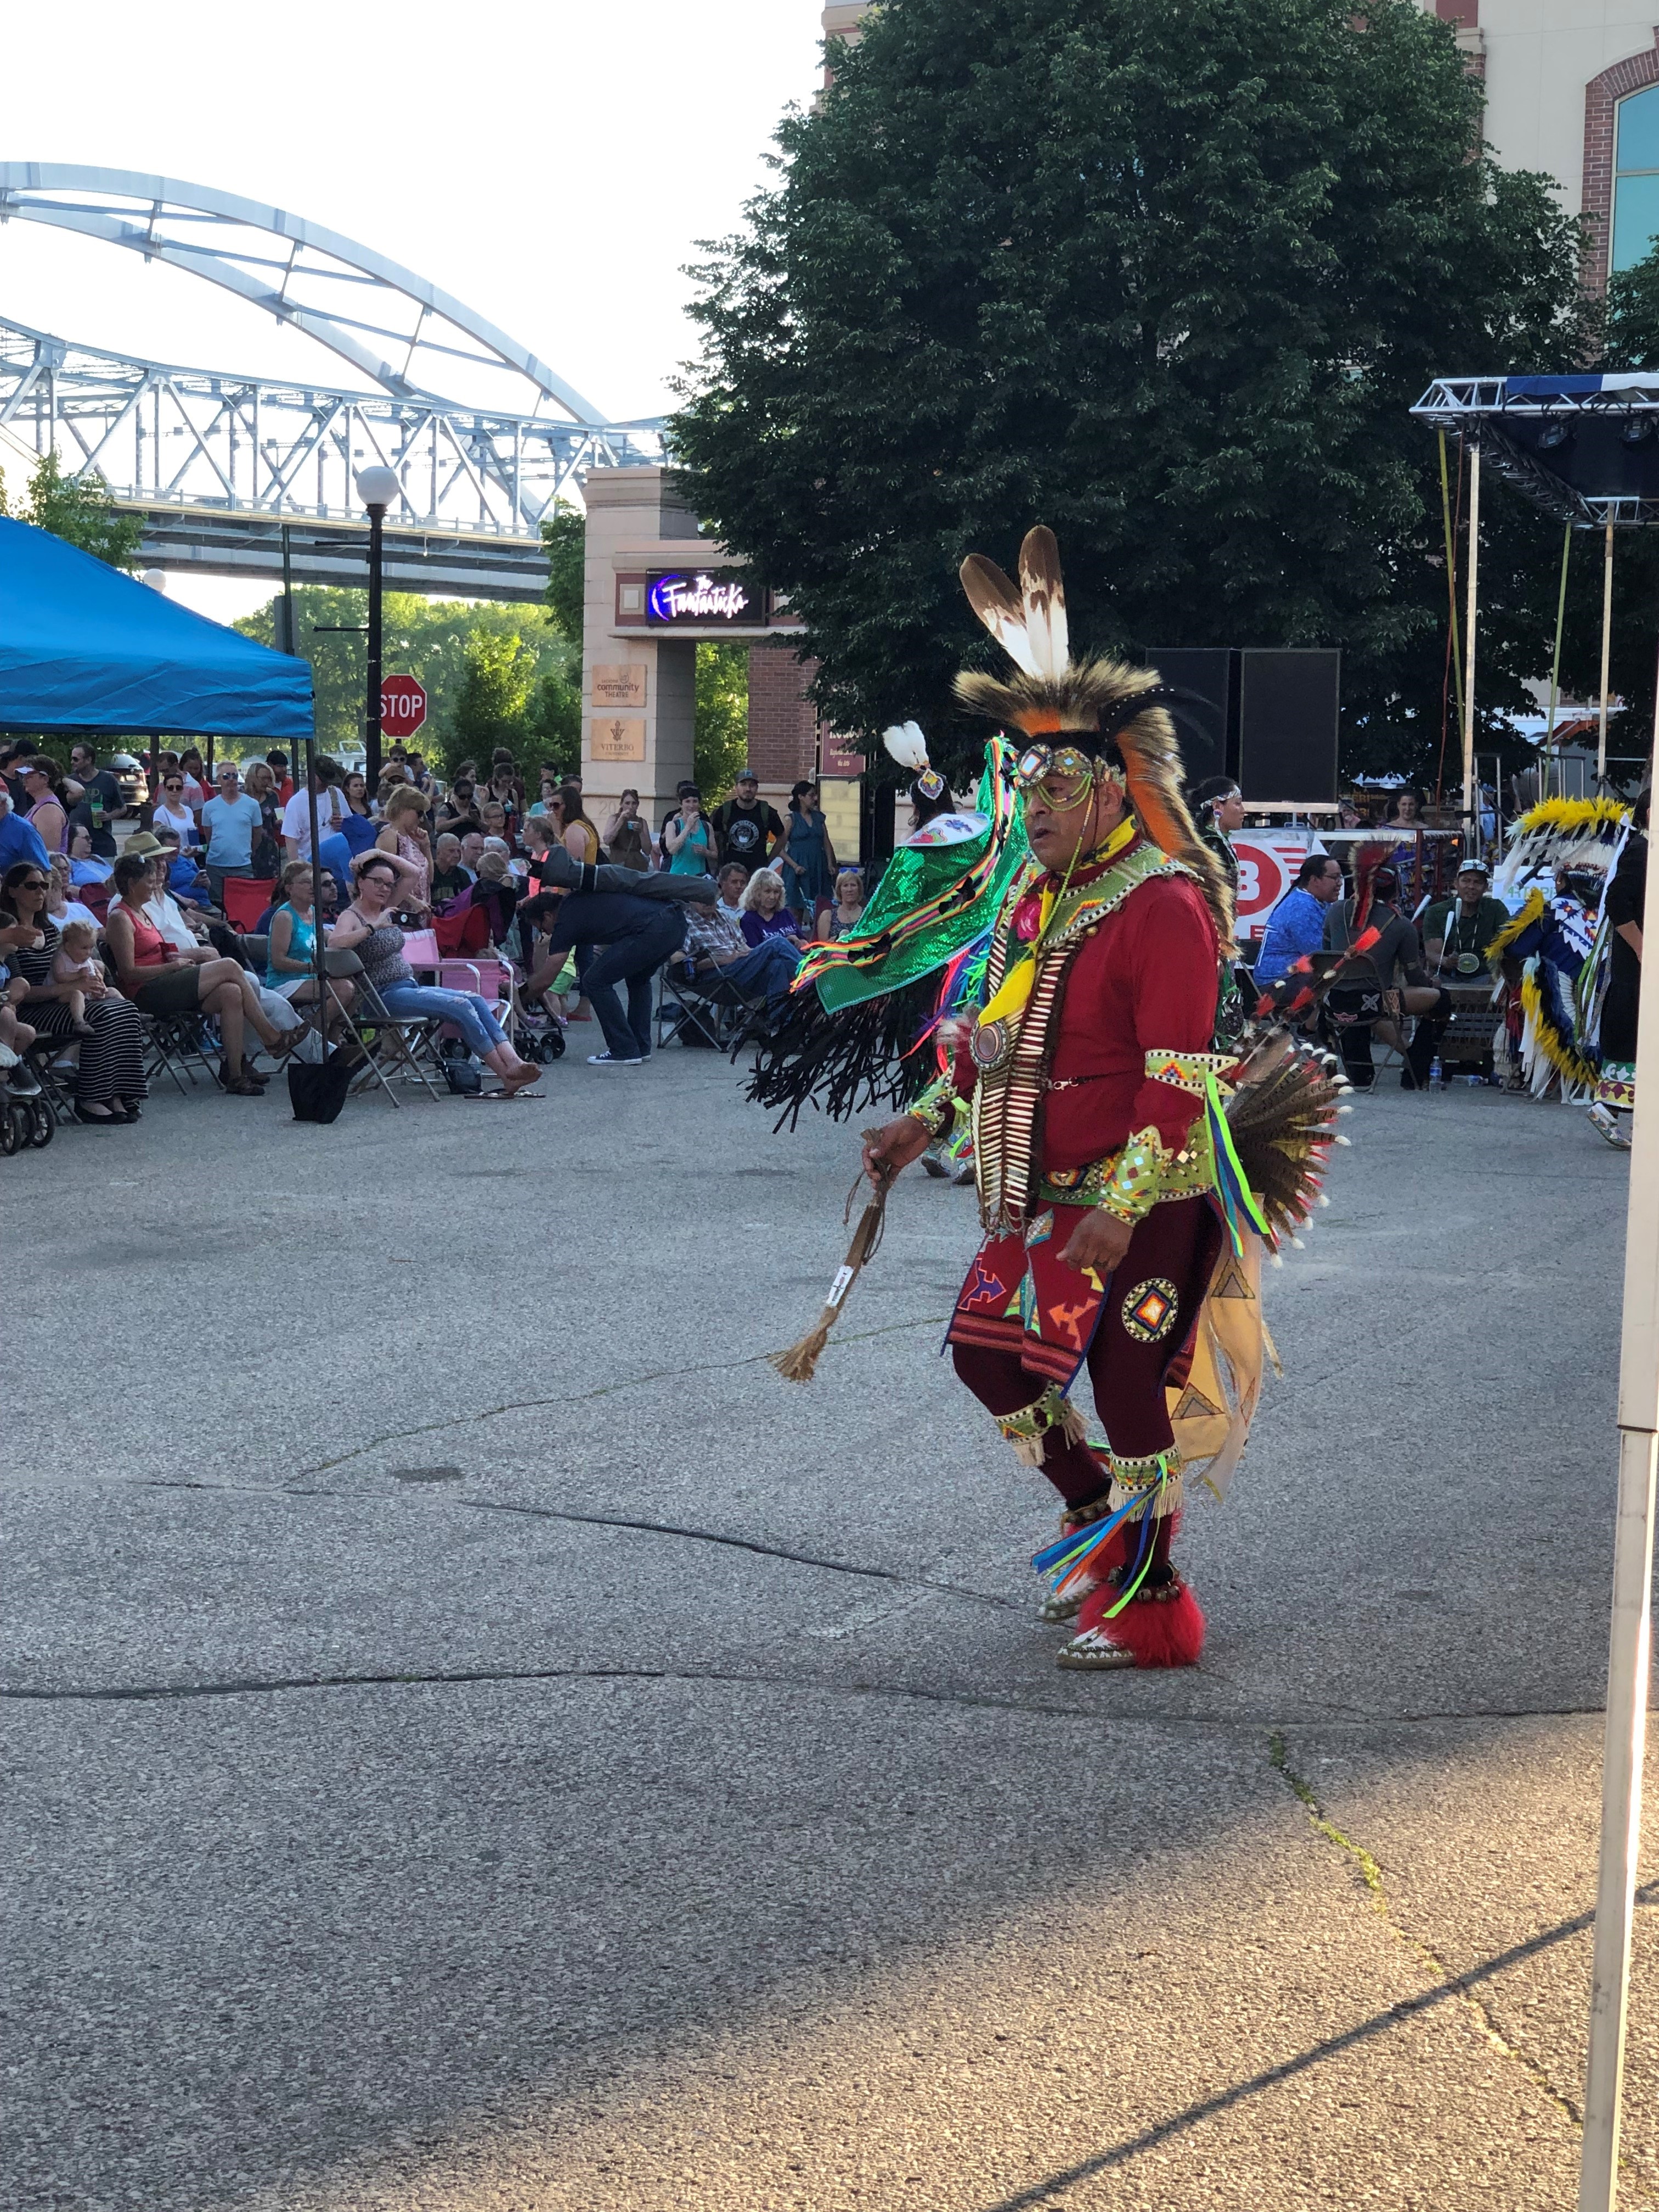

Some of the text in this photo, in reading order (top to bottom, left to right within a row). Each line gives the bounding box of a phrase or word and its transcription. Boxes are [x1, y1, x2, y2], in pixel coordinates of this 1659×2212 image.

[597, 682, 640, 693] community
[380, 694, 423, 718] STOP
[601, 743, 634, 751] VITERBO
